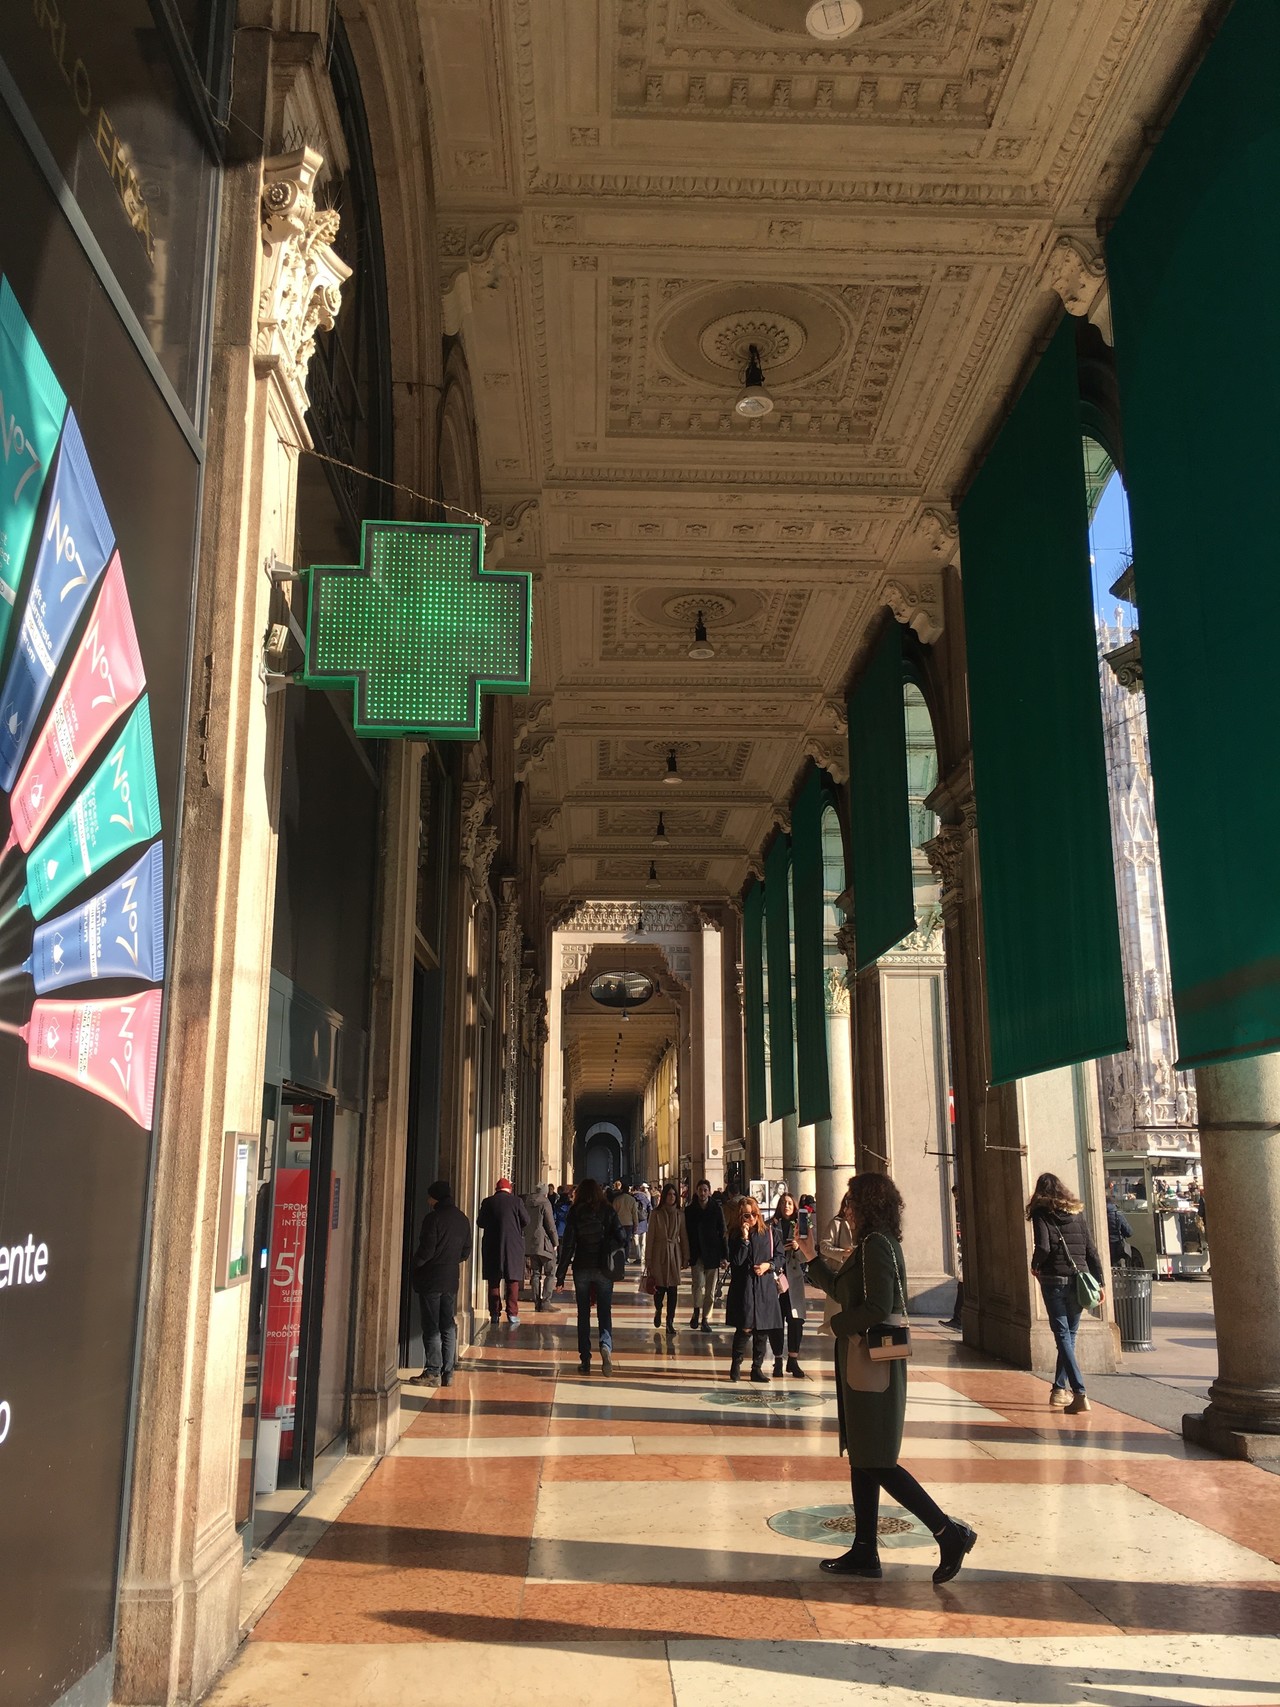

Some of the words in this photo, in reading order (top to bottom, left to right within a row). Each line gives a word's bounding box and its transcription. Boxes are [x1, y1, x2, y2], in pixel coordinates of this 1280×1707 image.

[47, 498, 88, 603] No7
[85, 618, 118, 710] No7
[109, 743, 136, 834] No7
[116, 874, 139, 967] No7
[93, 1008, 102, 1056] estore
[108, 1006, 137, 1098] No7
[282, 1219, 307, 1227] INTEG
[283, 1203, 307, 1211] PROM
[292, 1211, 307, 1219] SPE
